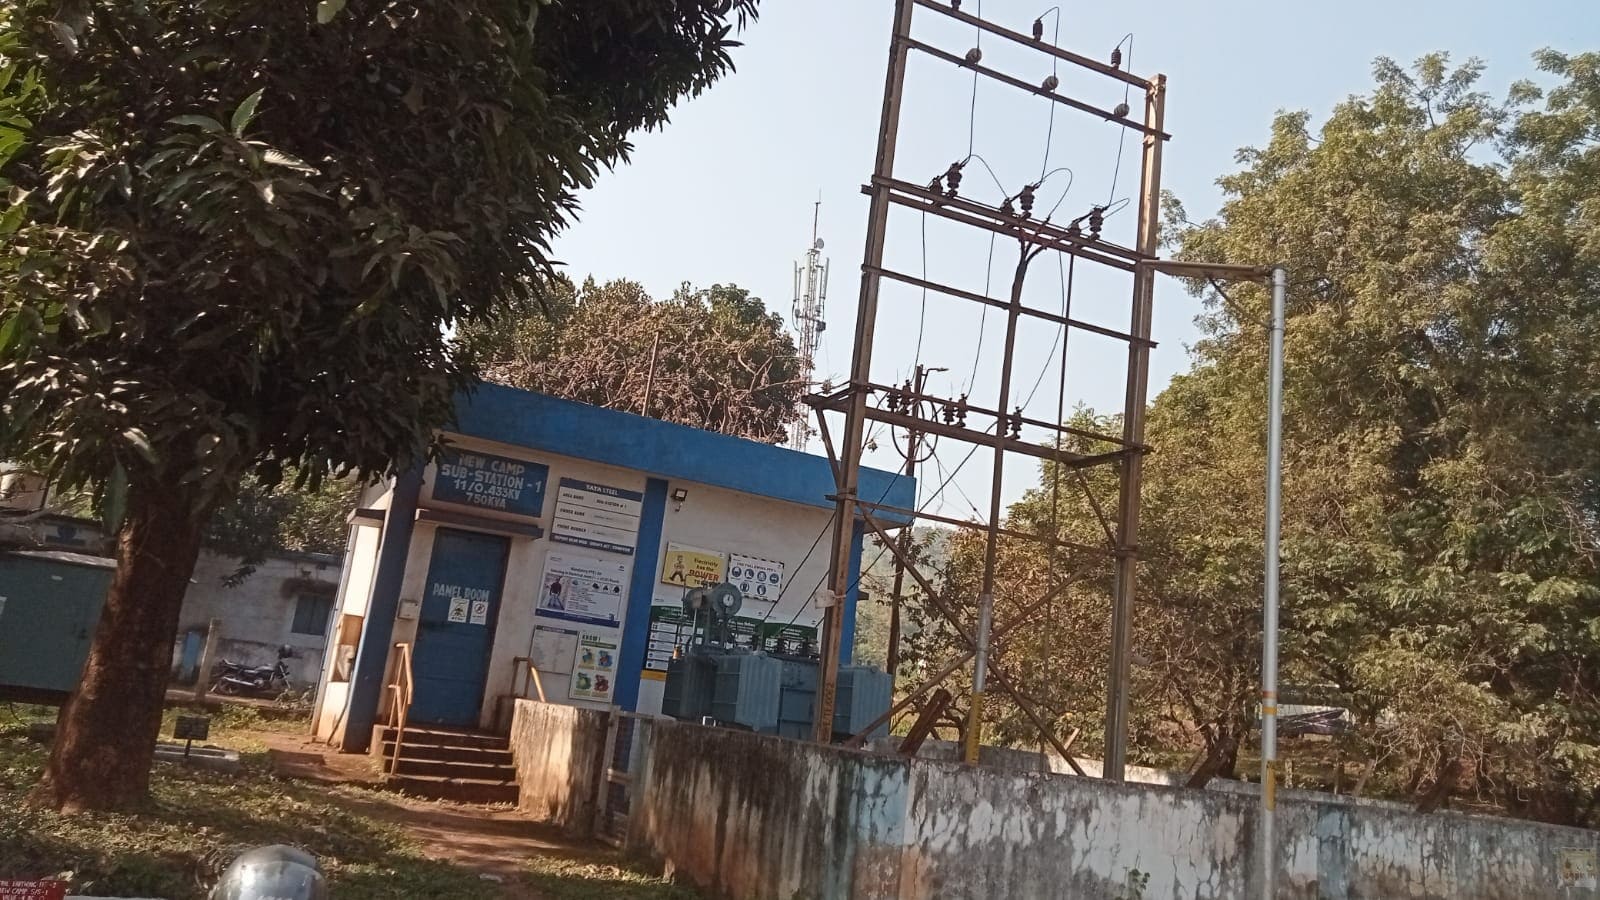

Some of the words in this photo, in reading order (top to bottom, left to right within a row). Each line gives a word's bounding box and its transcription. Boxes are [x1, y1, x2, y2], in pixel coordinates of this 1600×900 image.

[459, 455, 486, 468] NEW
[491, 461, 525, 474] CAMP
[441, 463, 524, 489] SUB-STATION
[586, 484, 601, 492] TATA
[466, 492, 506, 508] 750KVA
[694, 557, 718, 567] Electricity
[689, 570, 720, 581] POWER
[433, 583, 462, 598] PANEL
[464, 587, 490, 601] ROOM
